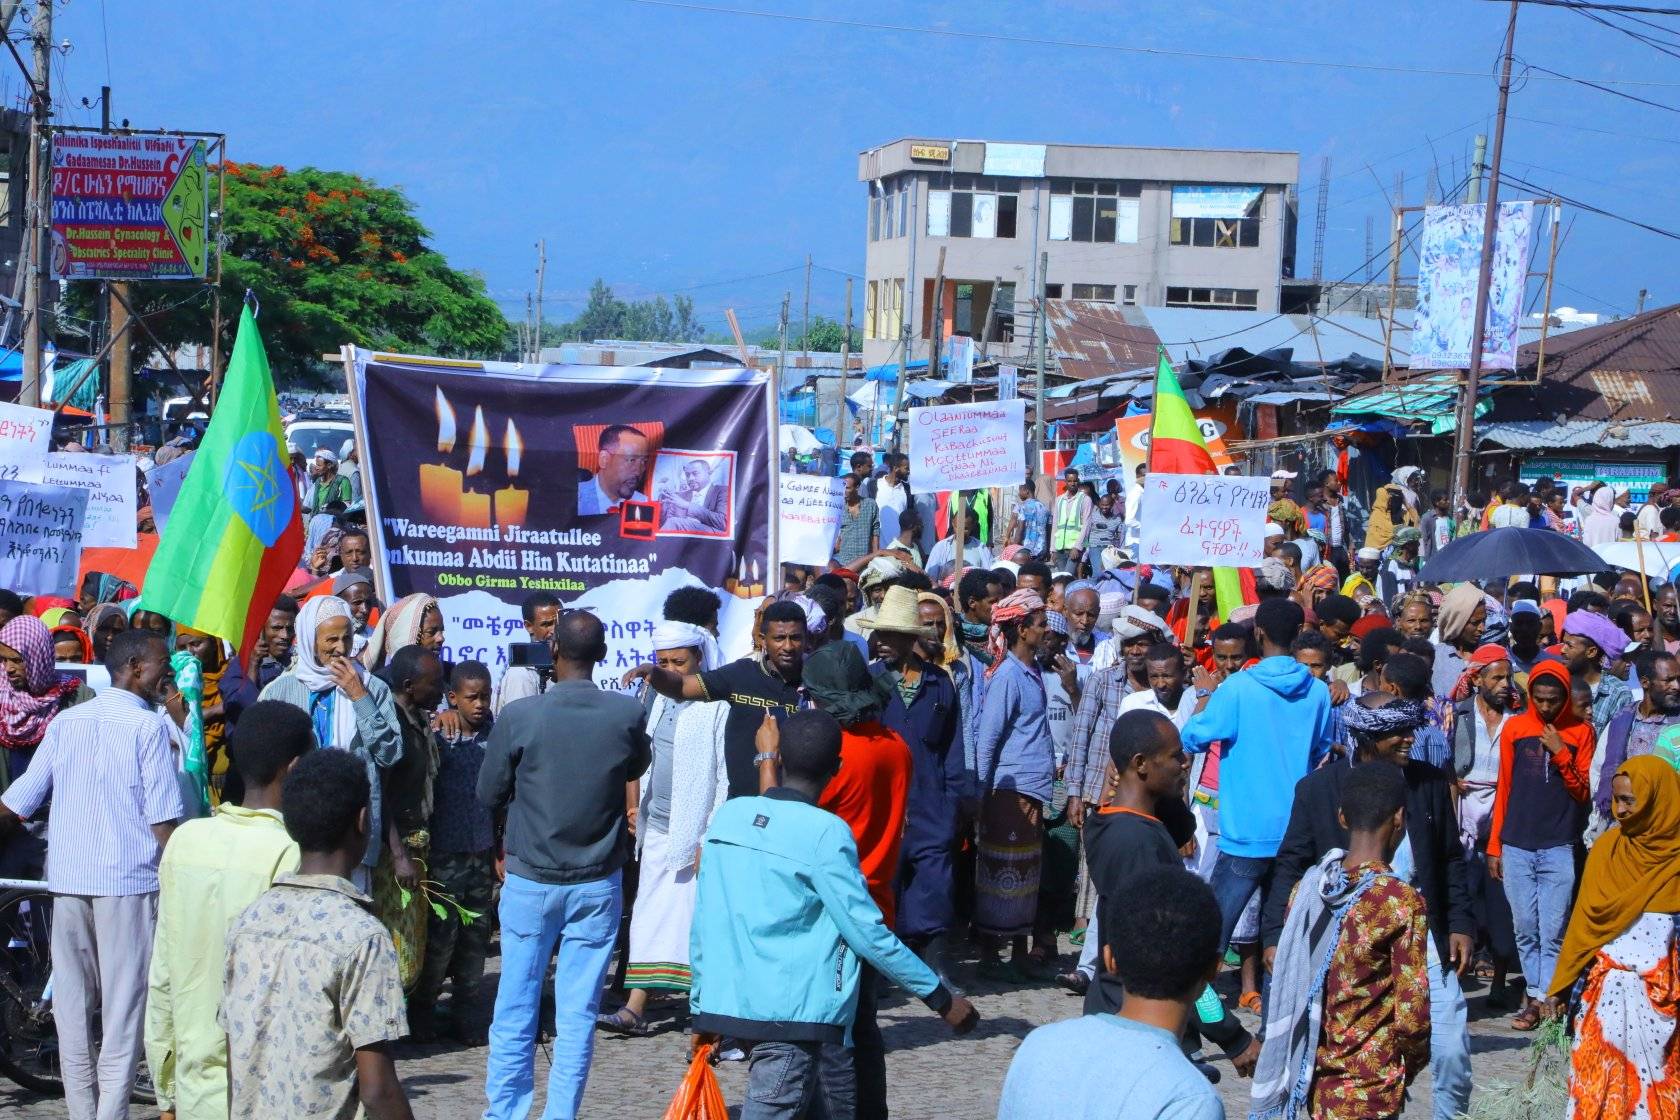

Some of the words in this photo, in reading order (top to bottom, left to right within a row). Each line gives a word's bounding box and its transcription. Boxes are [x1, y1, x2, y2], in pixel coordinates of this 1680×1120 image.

[503, 524, 602, 546] Jiraatullee
[468, 547, 518, 570] Abdii
[520, 549, 553, 572] Hin
[556, 552, 658, 574] Kutatinaa"
[437, 573, 473, 586] Obbo
[475, 574, 517, 589] Girma
[519, 576, 586, 591] Yeshixilaa
